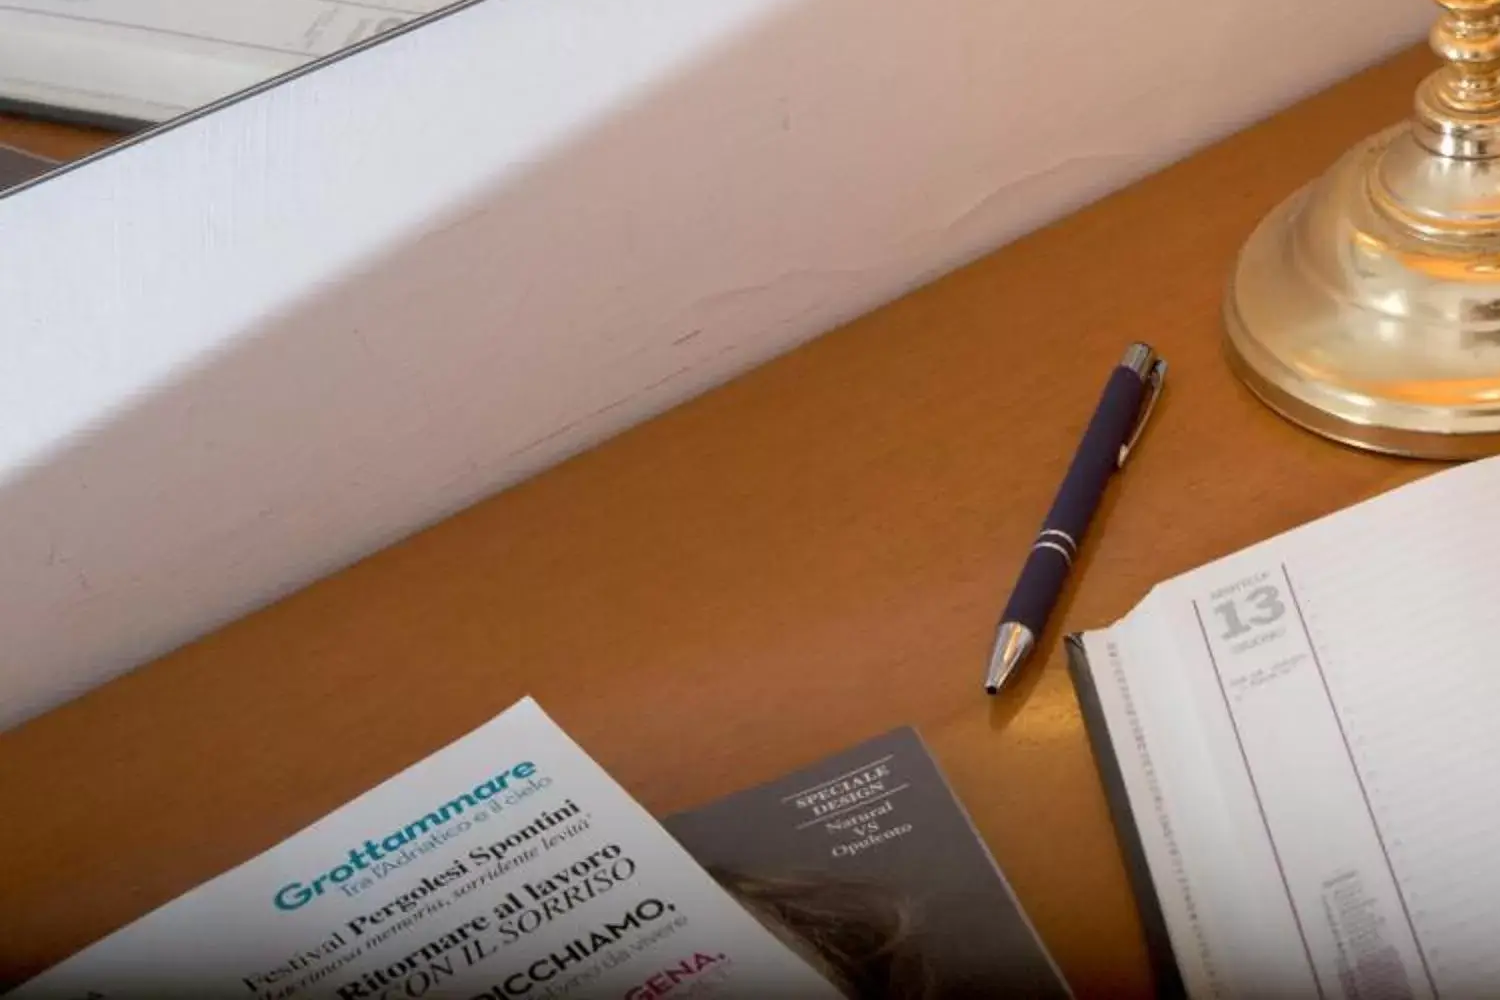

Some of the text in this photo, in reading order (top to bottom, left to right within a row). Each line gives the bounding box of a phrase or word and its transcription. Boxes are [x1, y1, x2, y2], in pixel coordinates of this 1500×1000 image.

[1213, 585, 1286, 640] 13
[795, 764, 890, 808] SPECIALE
[812, 780, 885, 816] DESIGN
[272, 760, 537, 911] Grottammare
[824, 799, 894, 834] Natural
[830, 822, 914, 857] Opulento
[852, 820, 881, 837] VS
[241, 798, 582, 994] Festival Pergolesi Spontini
[461, 938, 498, 967] IL
[496, 857, 637, 946] SORRISO
[336, 913, 491, 1000] Ritornare
[492, 892, 525, 922] al
[521, 843, 622, 901] lavoro
